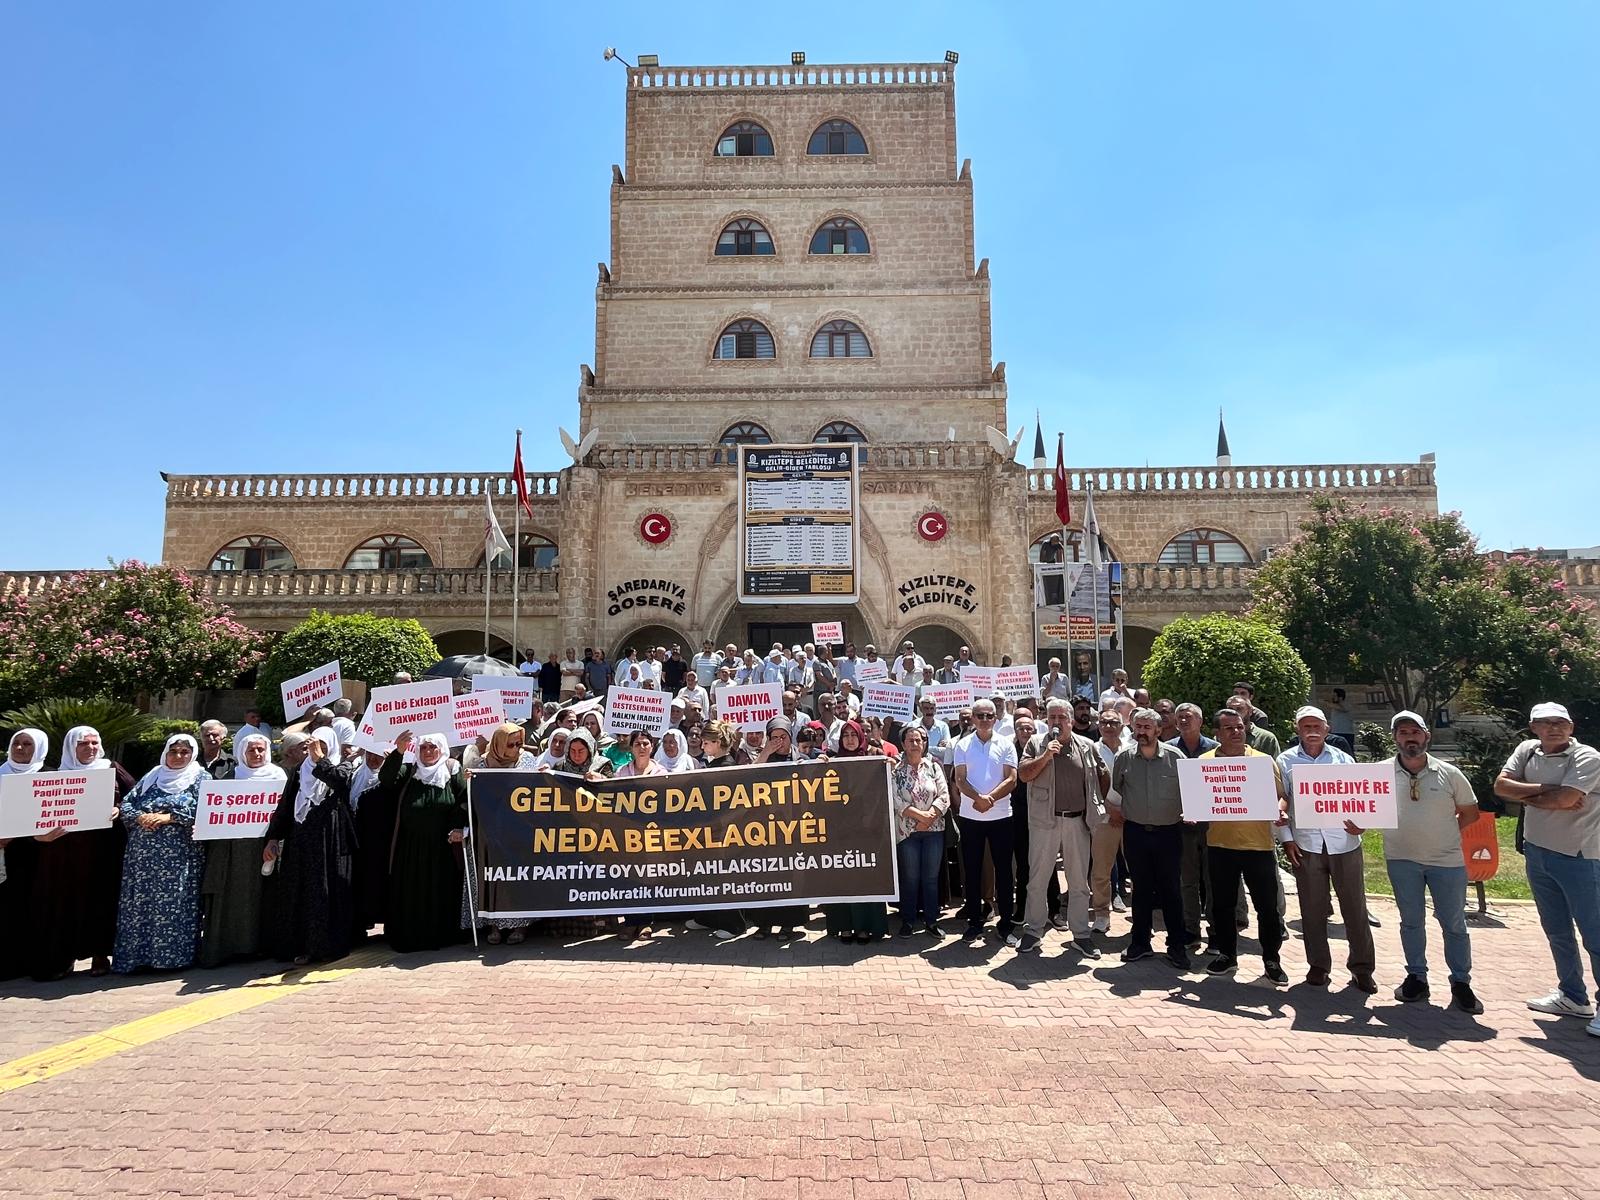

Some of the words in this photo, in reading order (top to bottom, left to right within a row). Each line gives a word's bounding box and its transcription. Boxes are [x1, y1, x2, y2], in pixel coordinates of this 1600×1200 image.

[761, 458, 794, 466] KIZILTEPE
[796, 457, 835, 465] BELEDİYESİ
[625, 483, 724, 496] BELEDİYE
[608, 578, 686, 602] ŞAREDARİYA
[898, 574, 976, 596] KIZILTEPE
[608, 596, 686, 616] QOSERÊ
[898, 589, 978, 614] BELEDİYESİ
[287, 692, 293, 701] JI
[294, 674, 327, 698] QIRÊJIYÊ
[328, 672, 337, 682] RE
[297, 696, 310, 708] CIH
[312, 689, 326, 703] NÎN
[326, 686, 331, 694] E
[375, 700, 392, 712] Gel
[394, 697, 407, 710] bê
[410, 694, 449, 708] Exlaqan
[456, 699, 479, 709] SATIŞA
[617, 693, 633, 702] VÎNA
[647, 696, 662, 704] NAYÊ
[728, 693, 770, 707] DAWIYA
[389, 710, 437, 725] naxweze!
[454, 706, 492, 719] ARDIKLARI
[612, 712, 635, 721] HALKIN
[636, 713, 662, 723] İRADESİ
[454, 716, 500, 730] TAŞINMAZLAR
[611, 721, 660, 732] GASPEDİLEMEZ!
[1201, 765, 1228, 773] Xizmet
[32, 778, 63, 787] Xizmet
[1205, 774, 1226, 784] Paqijî
[34, 788, 61, 797] Paqijî
[510, 787, 570, 812] GEL
[575, 787, 658, 814] DENG
[665, 787, 707, 813] DA
[713, 769, 850, 810] PARTİYÊ,
[1299, 782, 1310, 795] JI
[1313, 779, 1369, 796] QIRÊJIYÊ
[1374, 782, 1389, 794] RE
[207, 793, 222, 806] Te
[226, 792, 266, 808] şeref
[1214, 796, 1223, 804] Ar
[1314, 800, 1338, 813] CIH
[1342, 798, 1368, 813] NÎN
[1370, 800, 1376, 812] E
[1212, 806, 1228, 814] Fedî
[209, 811, 224, 824] bi
[534, 828, 620, 854] NEDA
[624, 812, 827, 853] BÊEXLAQİYÊ!
[484, 866, 530, 882] HALK
[532, 861, 606, 881] PARTİYE
[609, 864, 630, 878] OY
[634, 858, 691, 878] VERDİ,
[693, 852, 818, 875] AHLAKSIZLIĞA
[821, 850, 877, 869] DEĞİL!
[569, 886, 652, 902] Demokratik
[654, 883, 720, 899] Kurumlar
[722, 882, 792, 895] Platformu
